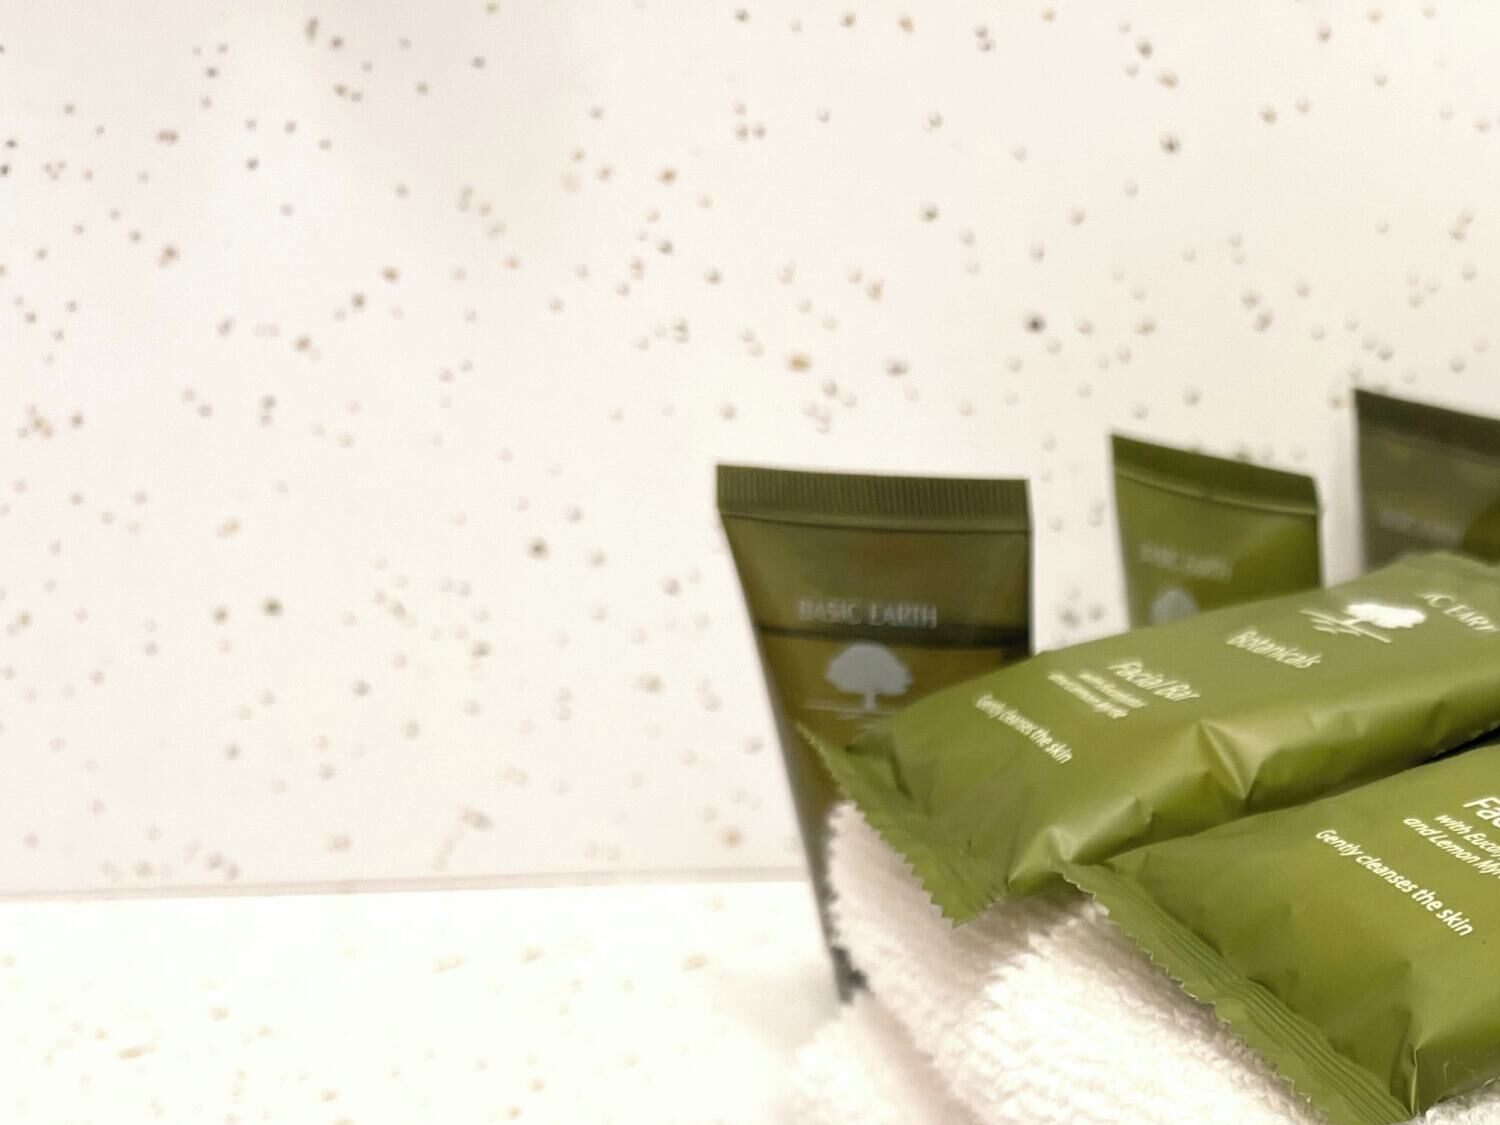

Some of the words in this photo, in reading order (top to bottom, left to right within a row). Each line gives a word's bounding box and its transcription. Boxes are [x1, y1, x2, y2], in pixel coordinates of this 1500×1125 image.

[1226, 629, 1322, 668] Botanicals
[1153, 682, 1200, 701] Bar
[1030, 727, 1054, 748] the
[1044, 742, 1073, 765] skin
[1403, 816, 1438, 837] and
[1429, 833, 1480, 865] Lemon
[1434, 813, 1473, 836] with
[1315, 828, 1363, 857] Gently
[1355, 850, 1418, 893] cleanses
[1411, 887, 1443, 912] the
[1436, 908, 1473, 936] skin
